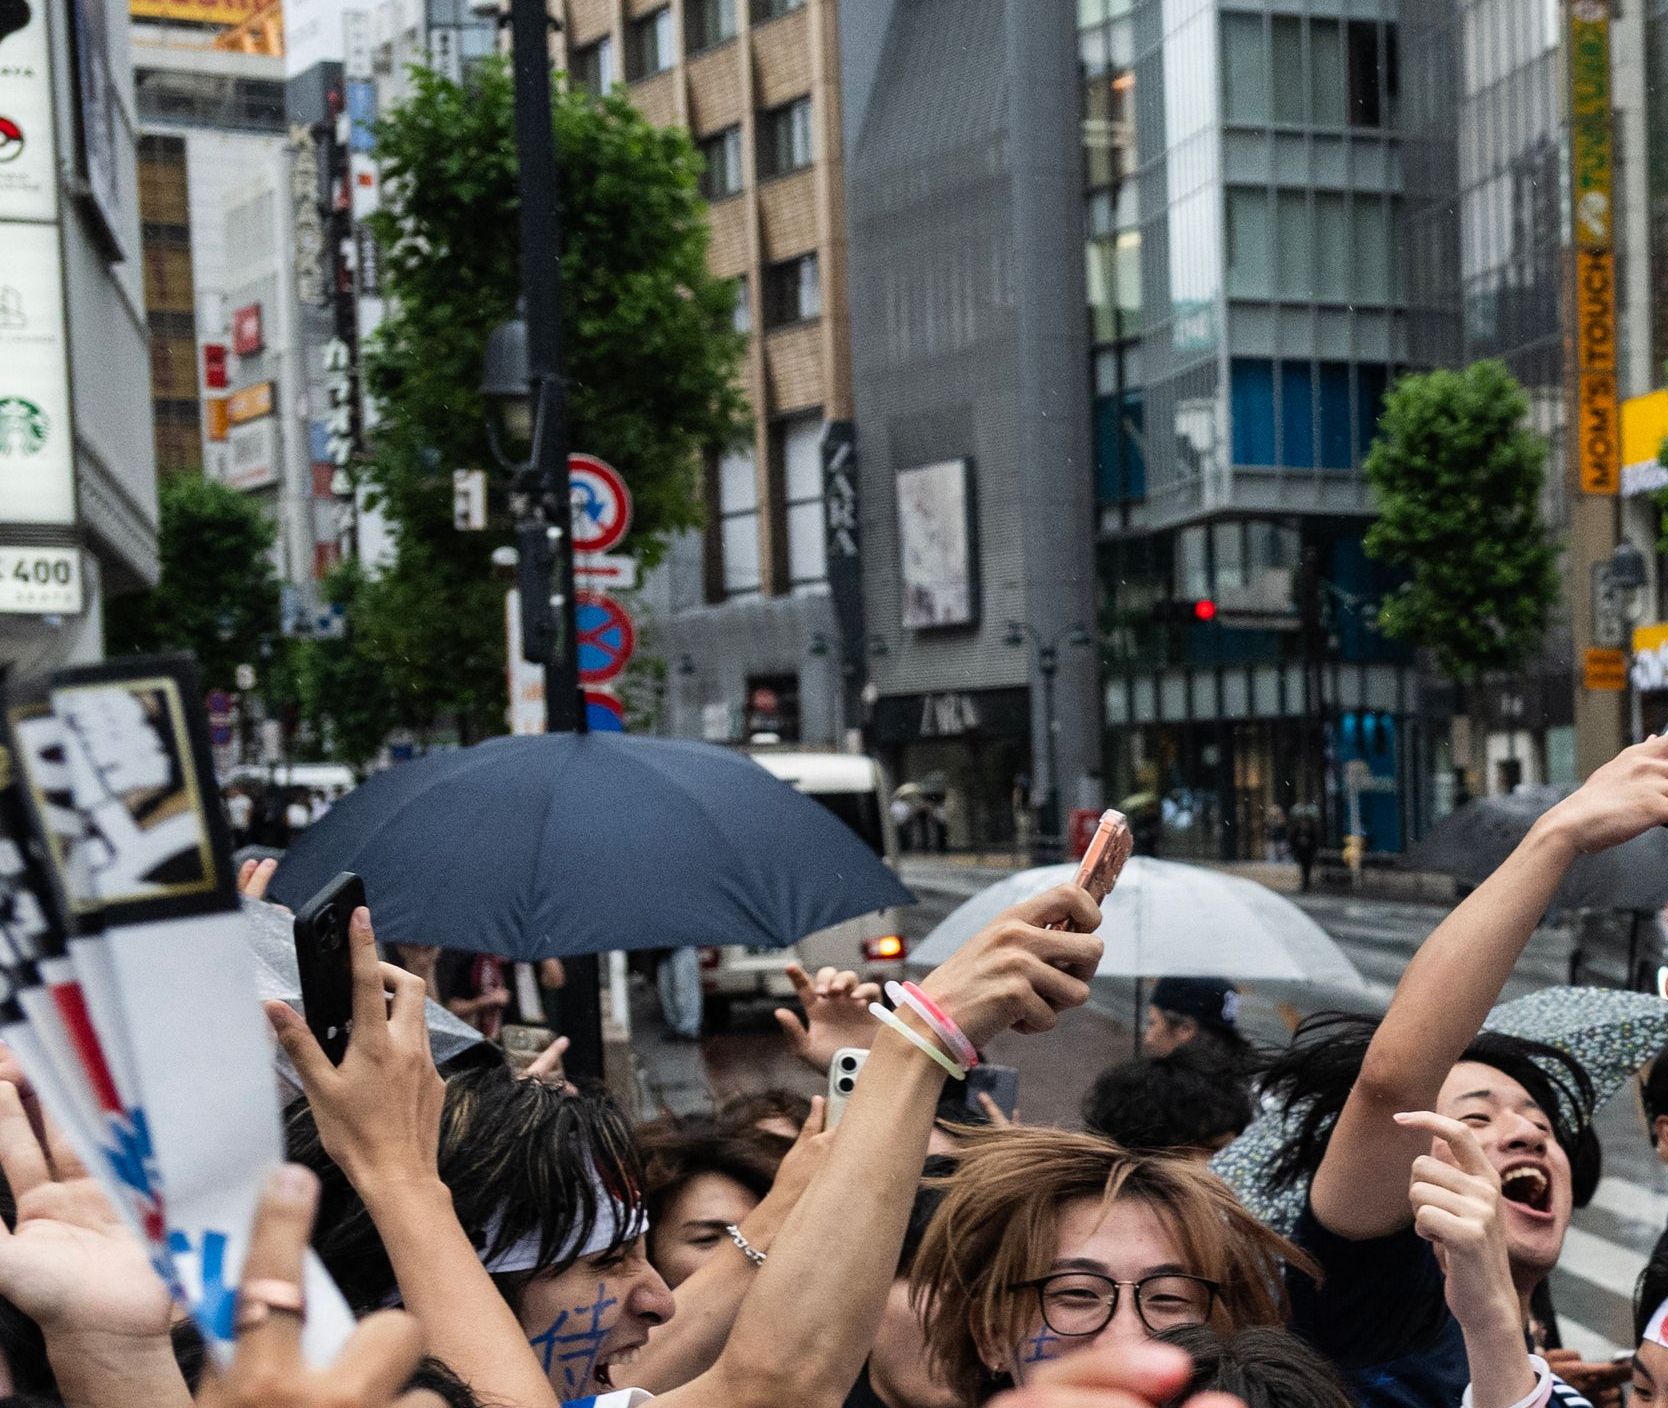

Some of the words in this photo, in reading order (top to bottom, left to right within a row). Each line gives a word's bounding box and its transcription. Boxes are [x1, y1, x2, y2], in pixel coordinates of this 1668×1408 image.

[1583, 247, 1611, 365] TOUCH
[13, 559, 71, 585] 400
[529, 1281, 618, 1398] 侍
